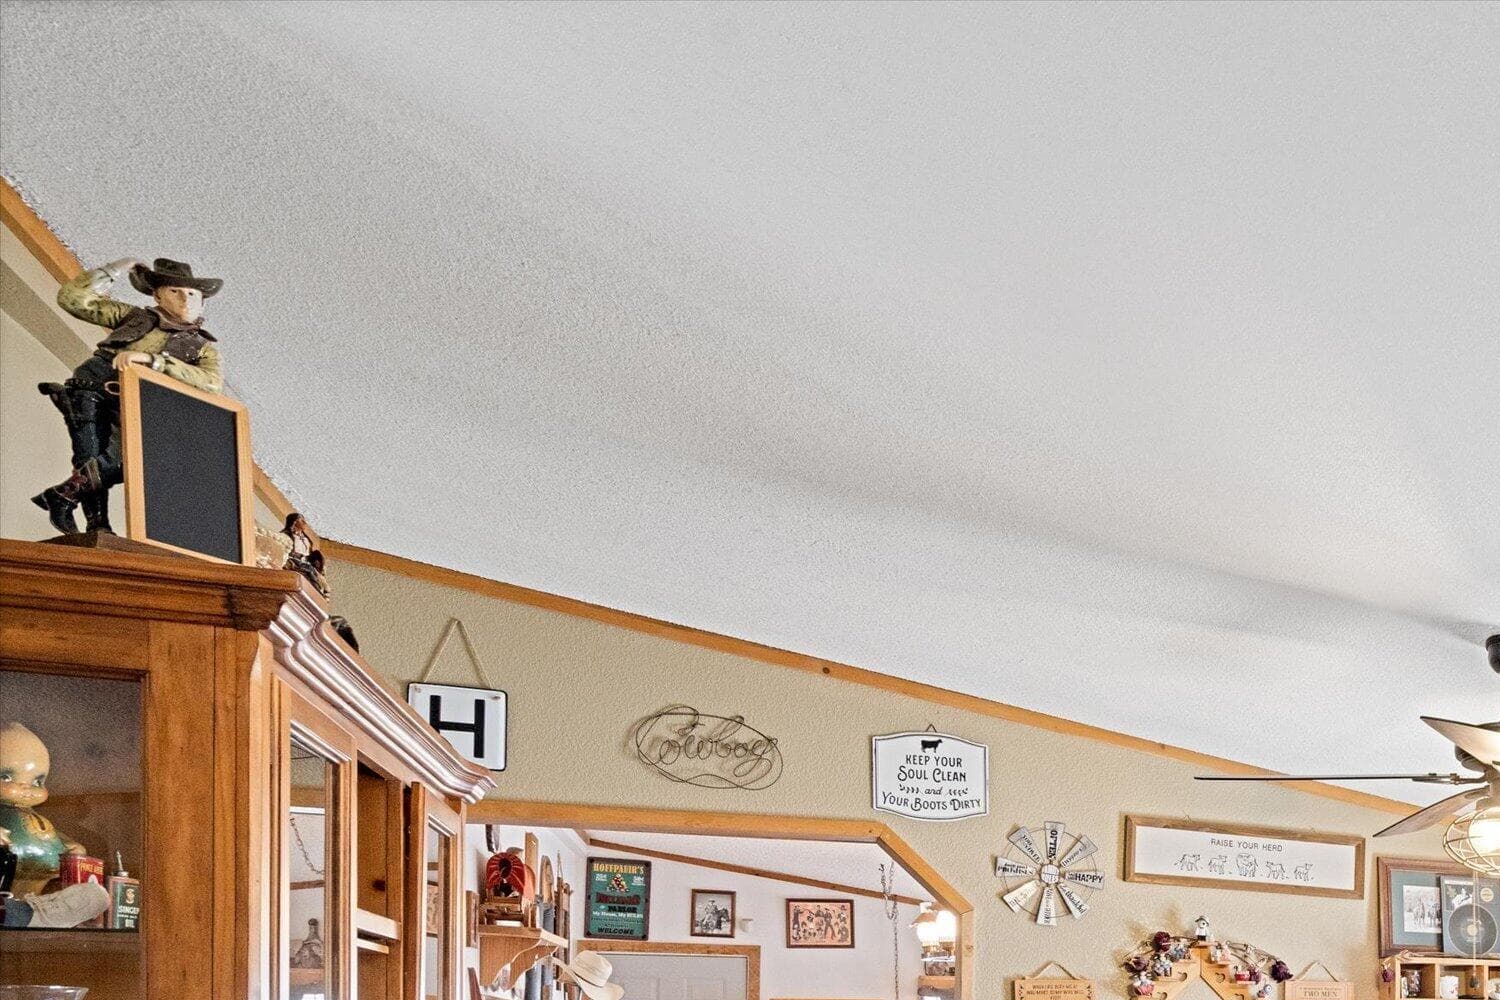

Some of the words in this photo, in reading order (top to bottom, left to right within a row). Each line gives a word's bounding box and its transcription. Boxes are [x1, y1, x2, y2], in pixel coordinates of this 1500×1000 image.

[429, 694, 486, 759] H
[905, 754, 931, 766] KEEP
[934, 756, 963, 768] YOUR
[897, 765, 929, 782] SOUL
[932, 768, 967, 783] CLEAN
[924, 786, 943, 796] and
[882, 791, 910, 807] YOUR
[910, 797, 948, 812] BOOTS
[950, 798, 981, 811] DIRTY
[1210, 838, 1234, 848] RAISE
[1237, 841, 1259, 850] YOUR
[1262, 843, 1283, 852] HERD
[1075, 873, 1104, 883] HAPPY
[598, 927, 634, 935] WELCOME
